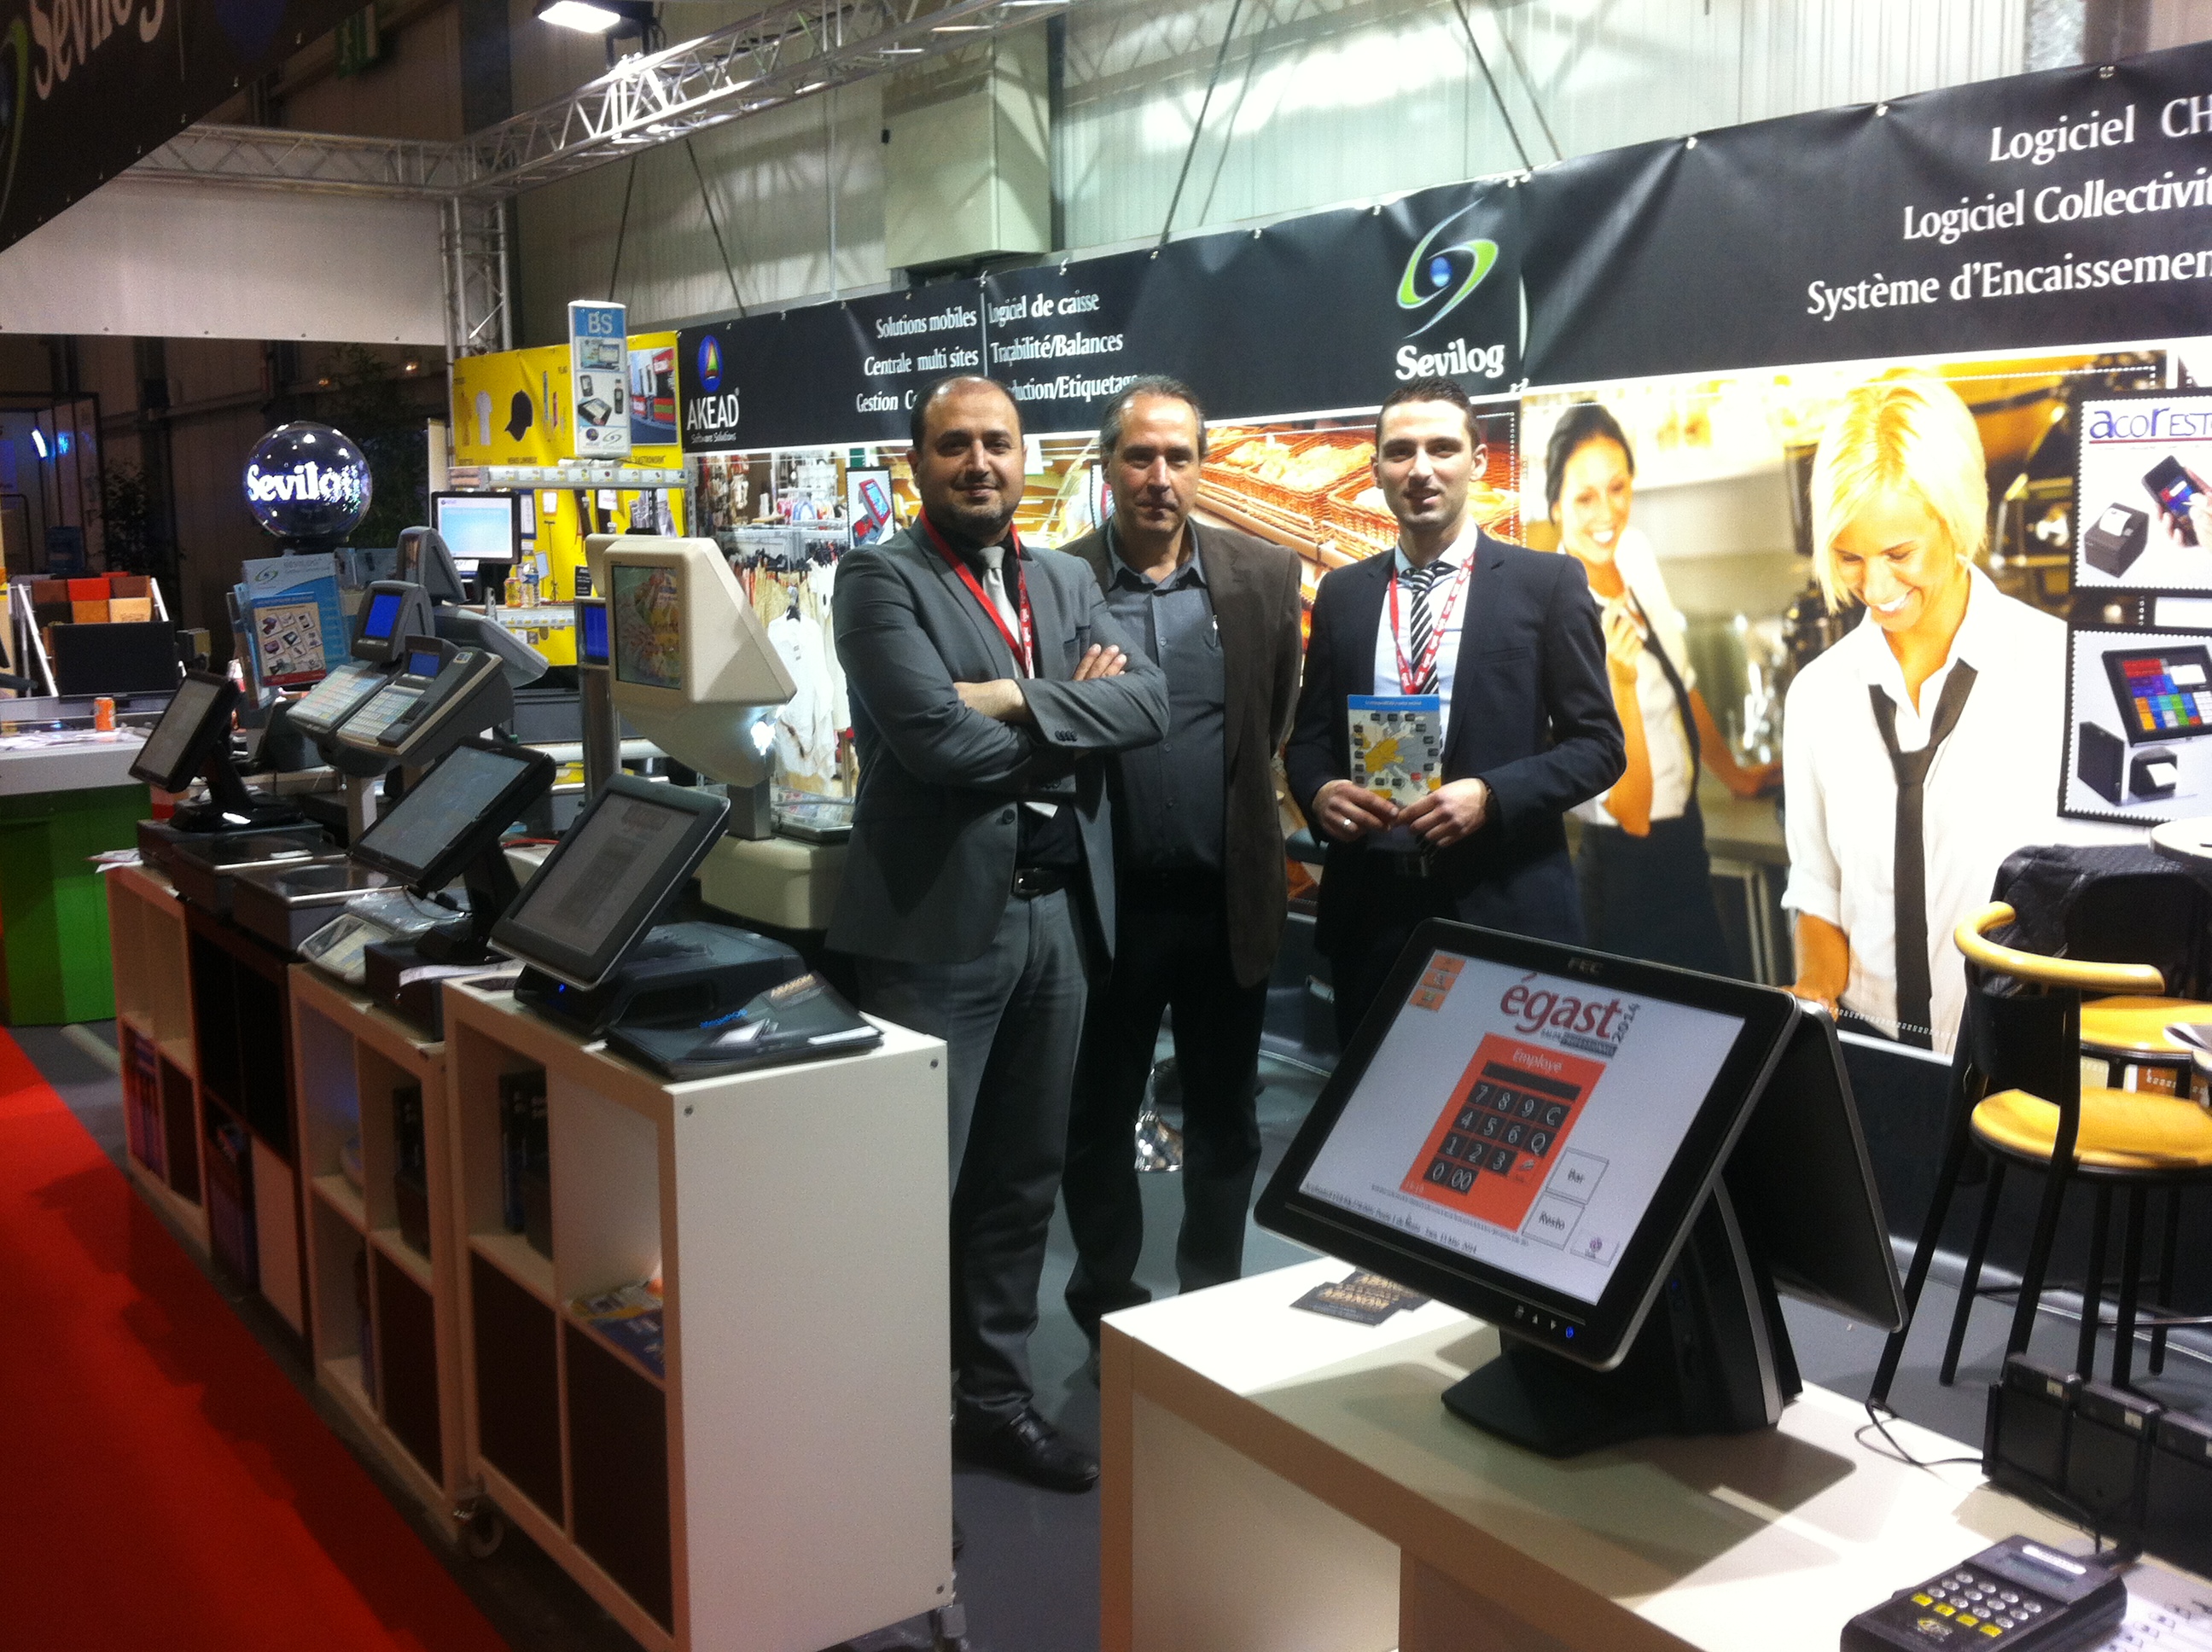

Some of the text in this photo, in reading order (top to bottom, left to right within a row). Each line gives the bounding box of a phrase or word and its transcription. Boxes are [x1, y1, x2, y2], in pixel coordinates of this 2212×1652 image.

[1989, 94, 2212, 165] Logiciel CH
[1903, 189, 2025, 244] Logiciel
[1031, 293, 1055, 317] de
[1057, 289, 1100, 315] caisse
[1807, 273, 1941, 322] Système
[588, 312, 614, 334] BS
[876, 305, 977, 339] Solutions mobiles
[864, 346, 979, 376] Centrale multi sites
[1395, 338, 1505, 380] Sevilog
[686, 393, 740, 431] AKEAD
[856, 391, 899, 413] Gestion
[1500, 971, 1622, 1039] égast
[1476, 1085, 1561, 1126] 7 8 9 C
[1461, 1111, 1474, 1128] 4
[1483, 1118, 1498, 1136] 5
[1508, 1125, 1521, 1143] 6
[1446, 1137, 1505, 1170] 1 2 3
[1433, 1163, 1472, 1190] 0 00
